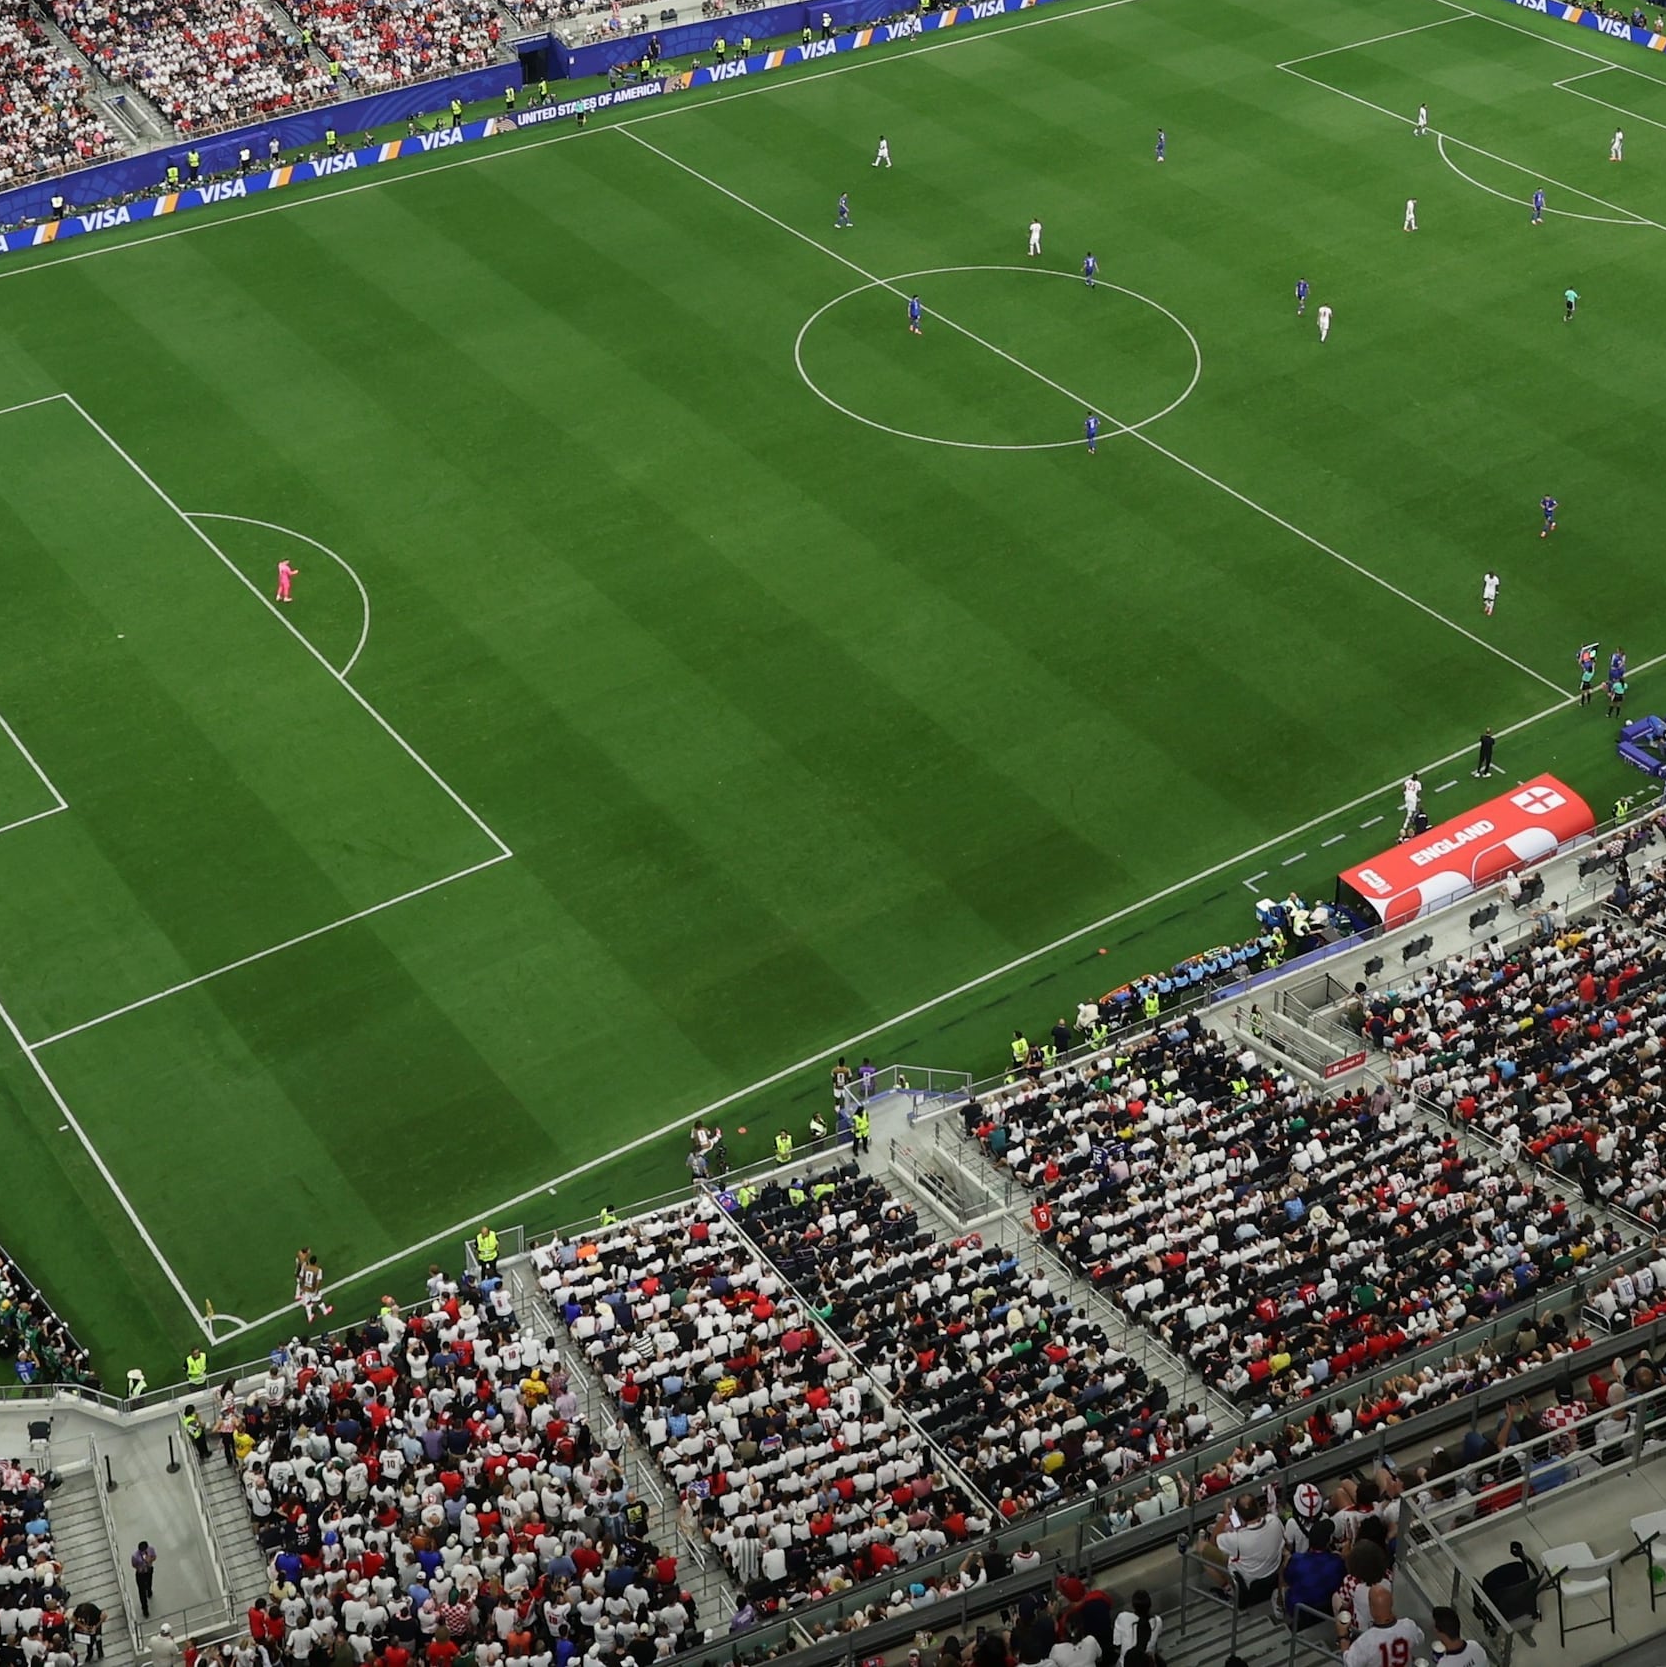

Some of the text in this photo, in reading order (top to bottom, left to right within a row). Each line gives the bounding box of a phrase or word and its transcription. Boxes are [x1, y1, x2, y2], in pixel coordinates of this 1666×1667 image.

[885, 19, 923, 40] VISA
[1596, 15, 1632, 41] VISA
[706, 58, 748, 83] VISA
[518, 106, 558, 127] UNITED
[597, 93, 613, 108] OF
[612, 82, 662, 105] AMERICA
[308, 151, 358, 177] VISA
[195, 178, 247, 204] VISA
[77, 206, 131, 233] VISA
[1409, 819, 1495, 868] ENGLAND
[1040, 1211, 1048, 1222] 9
[1266, 1303, 1275, 1318] 7
[1305, 1291, 1317, 1304] 10
[501, 1505, 512, 1517] 10
[1378, 1637, 1410, 1667] 19
